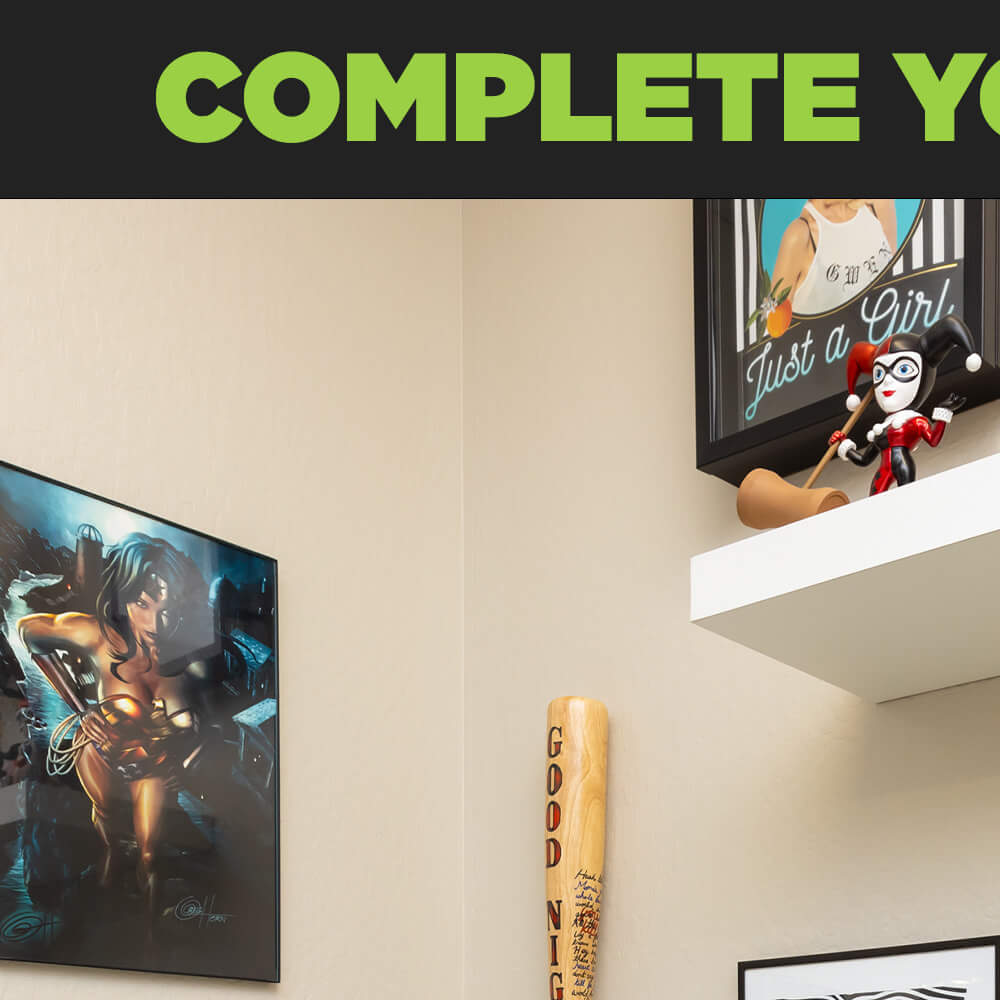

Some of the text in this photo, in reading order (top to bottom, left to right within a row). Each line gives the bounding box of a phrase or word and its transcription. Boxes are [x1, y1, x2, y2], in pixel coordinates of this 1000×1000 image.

[746, 278, 954, 421] Just a Girl
[546, 726, 563, 868] GOOD
